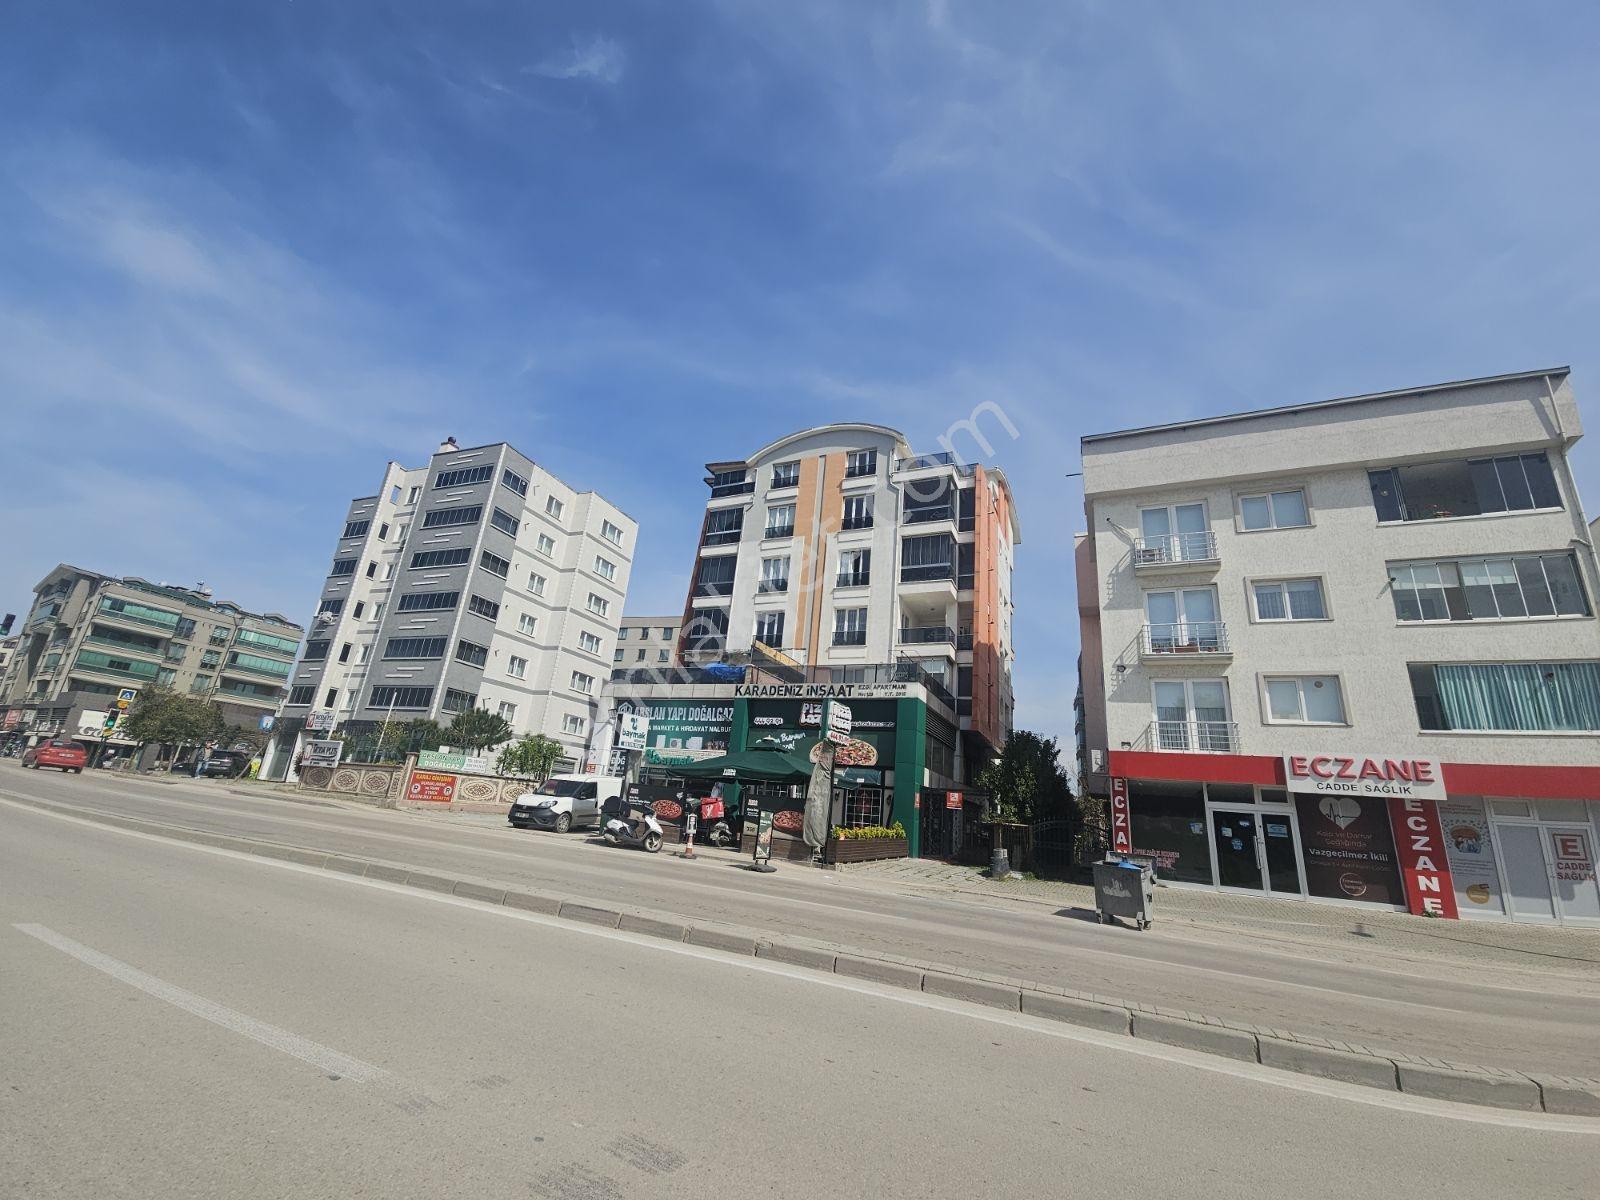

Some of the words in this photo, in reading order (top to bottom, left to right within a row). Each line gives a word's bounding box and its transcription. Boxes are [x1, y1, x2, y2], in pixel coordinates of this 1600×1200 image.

[668, 707, 686, 721] YAPI
[688, 705, 734, 722] DOĞALGAZ
[622, 728, 646, 739] baymak
[1290, 756, 1436, 783] ECZANE
[1316, 782, 1358, 792] CADDE
[1365, 784, 1412, 795] SAĞLIK
[1114, 778, 1128, 854] ECZA
[1309, 848, 1369, 861] Vazgeçilmez
[1403, 799, 1444, 916] ECZANE
[1556, 862, 1592, 871] CADDE
